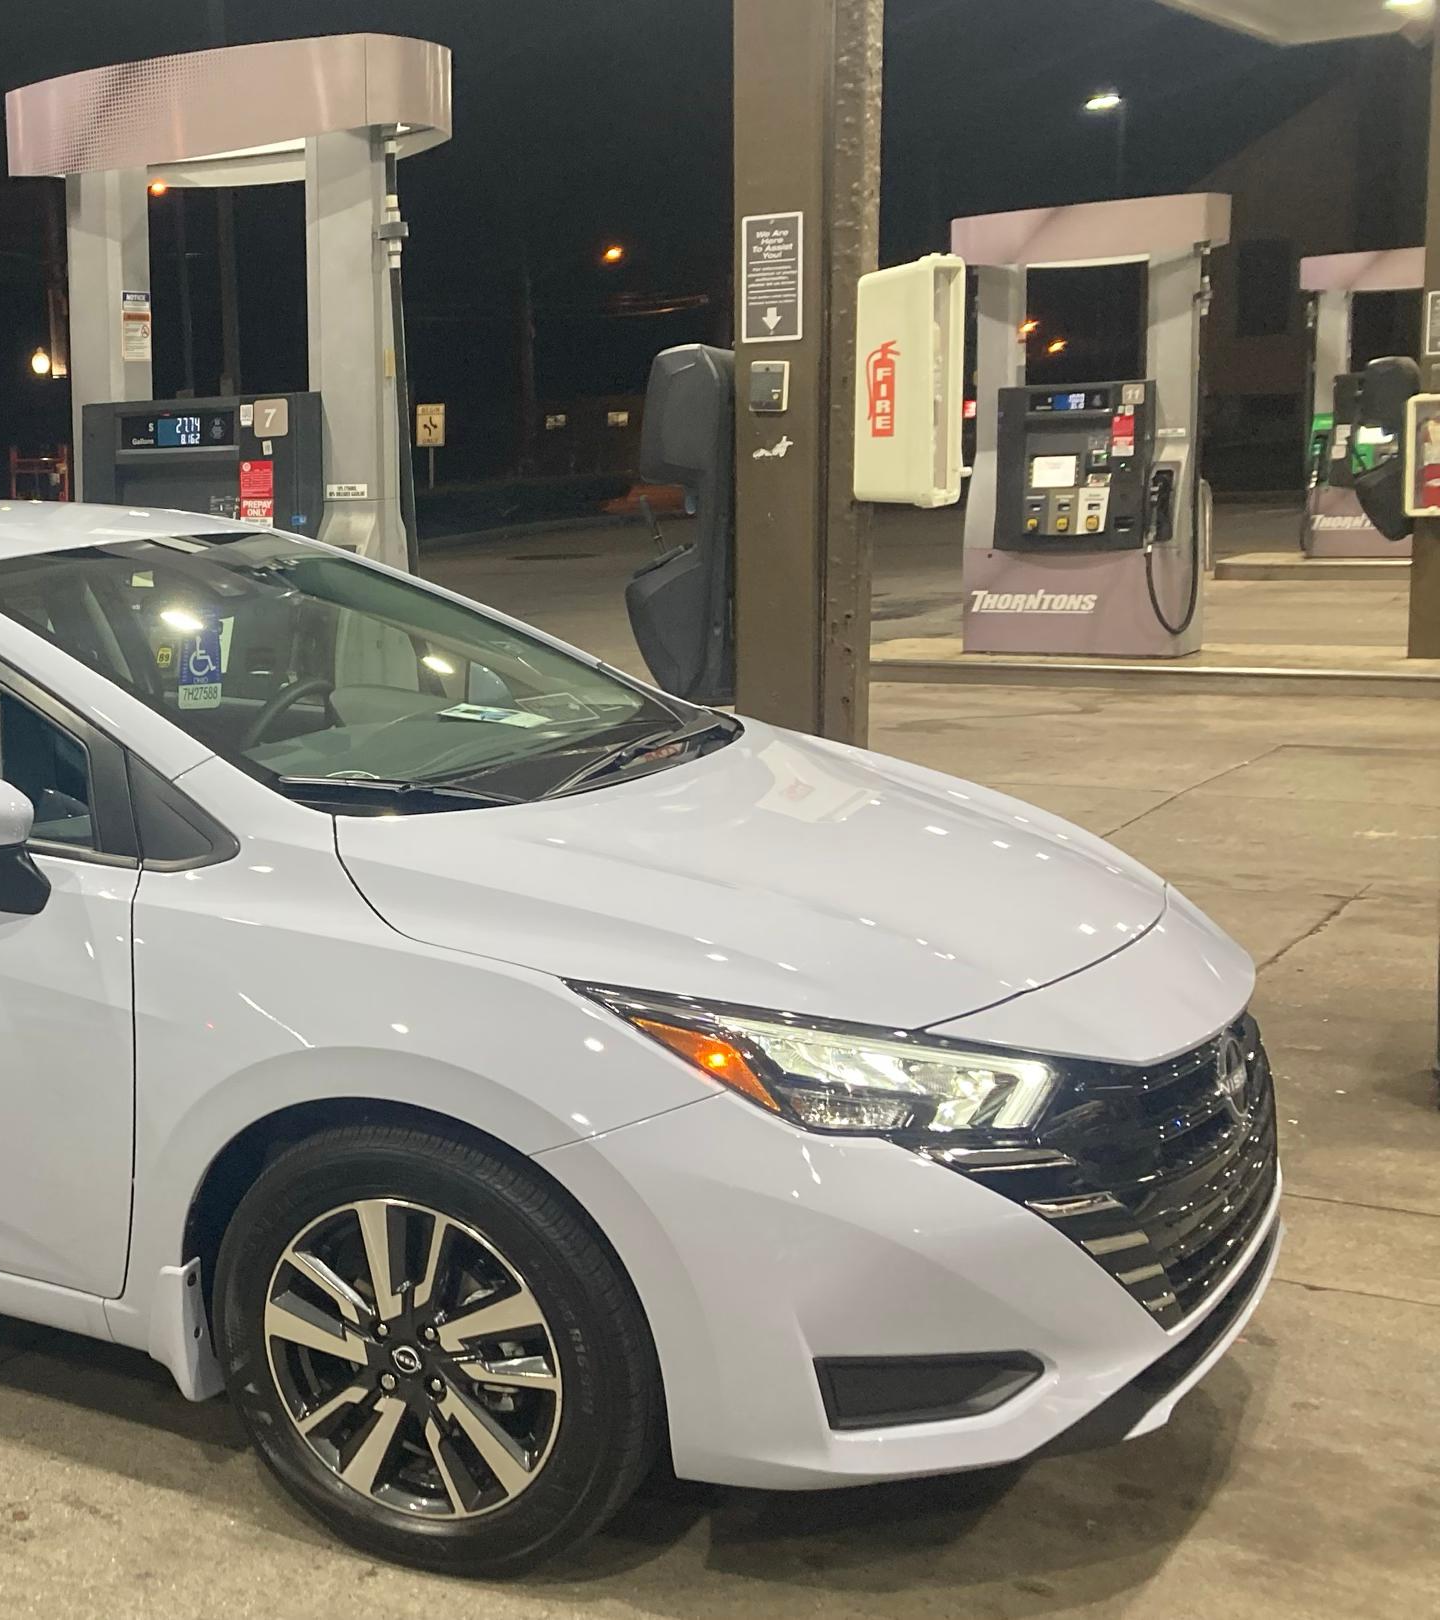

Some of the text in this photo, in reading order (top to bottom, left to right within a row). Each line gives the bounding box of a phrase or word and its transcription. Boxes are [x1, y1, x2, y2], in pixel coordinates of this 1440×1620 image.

[756, 229, 790, 239] We Are
[752, 243, 793, 253] To Assist
[875, 367, 892, 430] FIRE
[1126, 389, 1141, 398] 11
[264, 408, 276, 428] 7
[242, 500, 272, 509] PREPAY
[246, 508, 267, 516] ONLY
[971, 588, 1098, 613] THORNTONS
